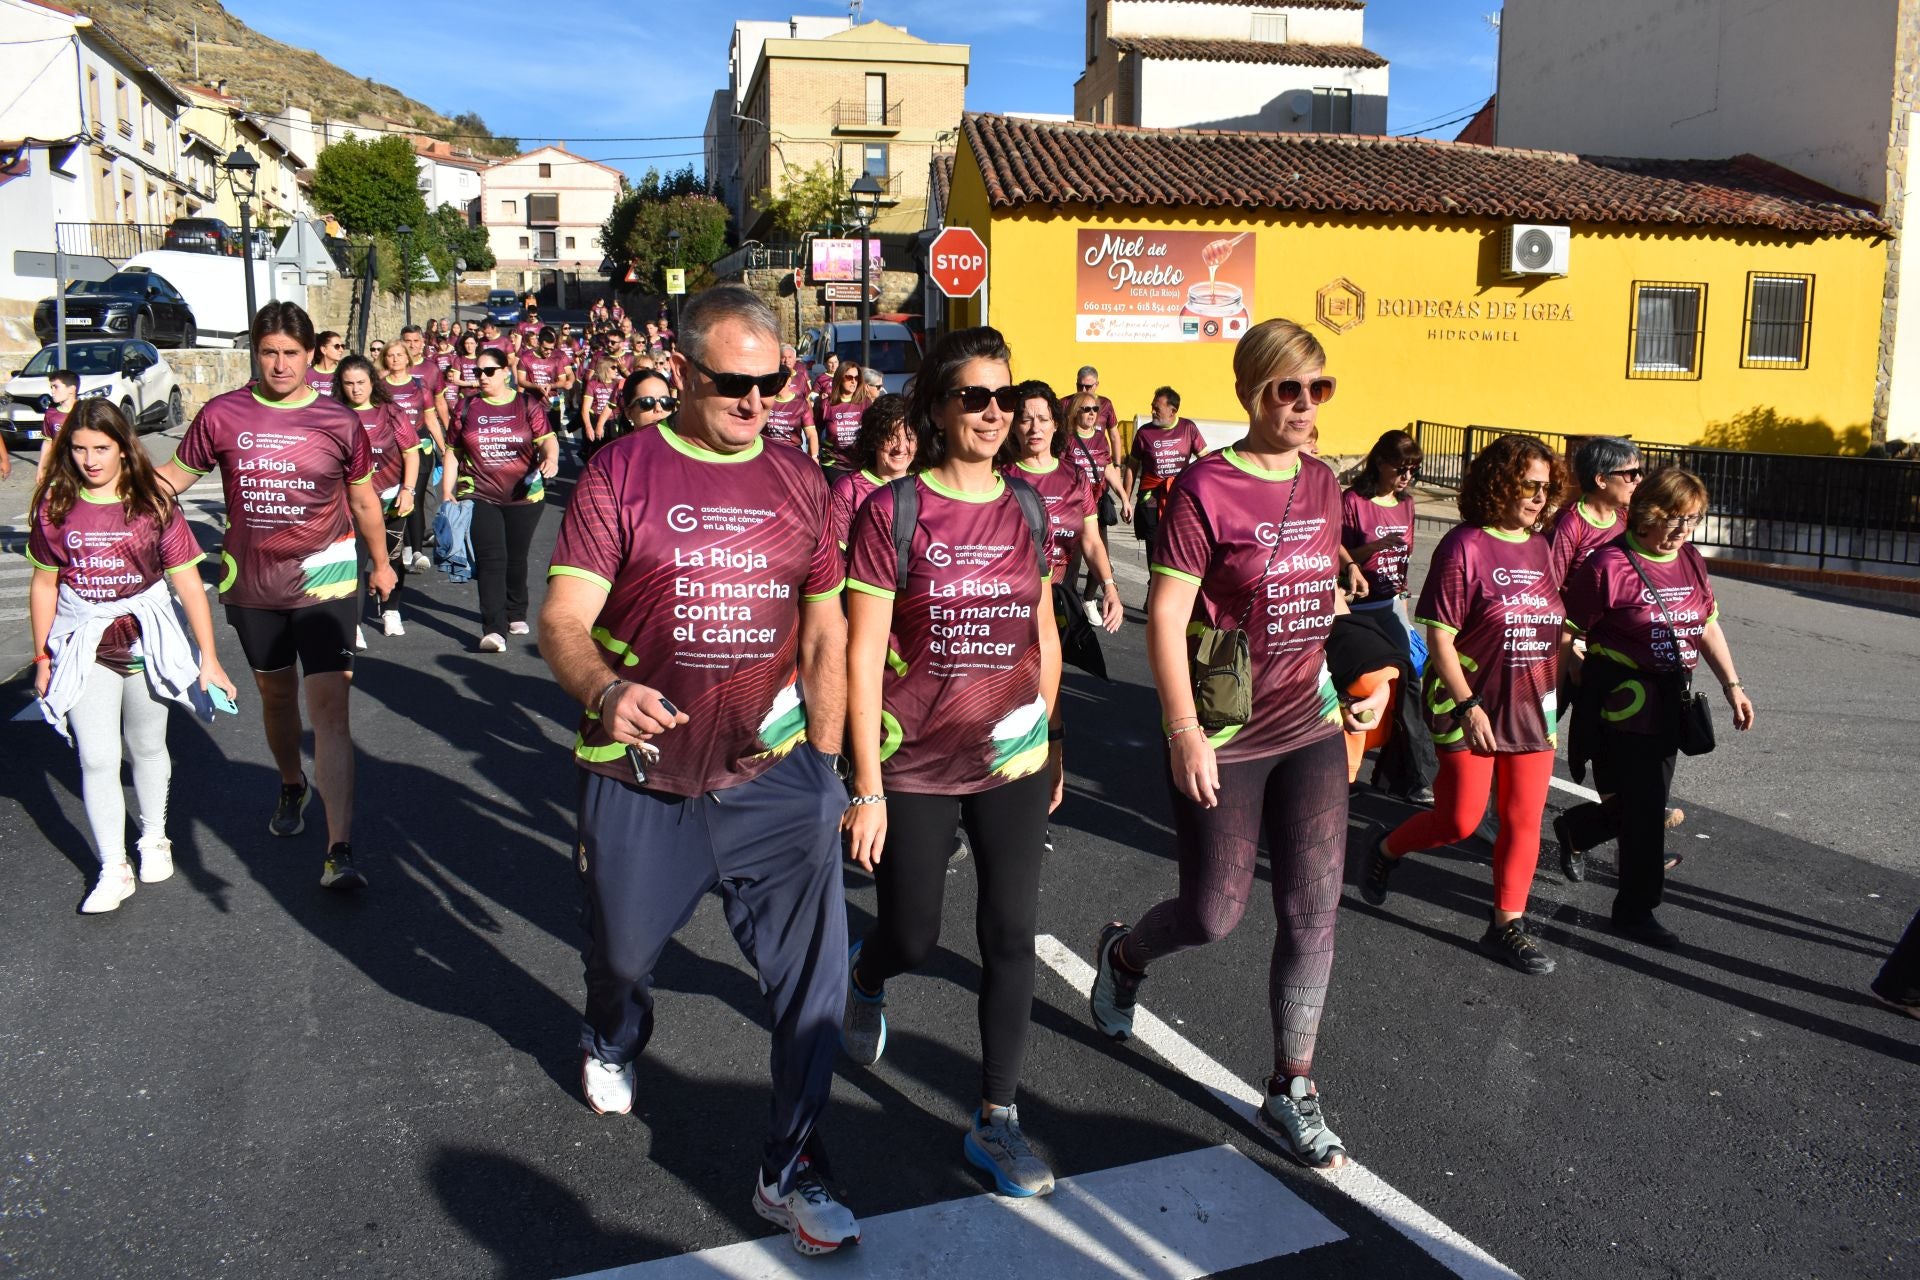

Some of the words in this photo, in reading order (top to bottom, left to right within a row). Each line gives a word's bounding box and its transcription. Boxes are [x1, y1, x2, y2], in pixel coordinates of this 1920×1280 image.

[1085, 233, 1144, 266] Miel
[1147, 243, 1167, 256] del
[936, 254, 983, 271] STOP
[1108, 258, 1185, 290] Pueblo
[1130, 288, 1148, 297] IGEA
[1150, 288, 1160, 298] (La
[1161, 288, 1180, 299] Rioja)
[1084, 302, 1100, 311] 660
[1101, 303, 1112, 312] 115
[1114, 303, 1126, 312] 417
[1137, 302, 1150, 311] 618
[1152, 303, 1165, 312] 854
[1167, 303, 1179, 312] 401
[1377, 298, 1480, 319] BODEGAS
[1487, 301, 1516, 320] DE
[1523, 302, 1575, 321] IGEA
[1427, 329, 1520, 342] HIDROMIEL
[479, 435, 490, 443] En
[492, 435, 524, 443] marcha
[481, 450, 490, 458] el
[238, 459, 255, 470] La
[258, 458, 296, 474] Rioja
[240, 476, 256, 487] En
[260, 478, 315, 490] marcha
[242, 490, 286, 502] contra
[243, 501, 254, 513] el
[256, 503, 306, 515] cáncer
[701, 506, 742, 514] asociación
[744, 508, 776, 517] española
[715, 523, 724, 531] La
[726, 524, 746, 533] Rioja
[738, 516, 763, 524] cáncer
[72, 557, 87, 568] La
[90, 556, 125, 570] Rioja
[674, 547, 704, 567] La
[711, 548, 768, 573] Rioja
[1265, 559, 1289, 575] La
[1292, 553, 1332, 571] Rioja
[76, 574, 88, 585] En
[91, 573, 143, 585] marcha
[675, 577, 705, 597] En
[711, 579, 790, 599] marcha
[929, 580, 956, 597] La
[962, 578, 1011, 599] Rioja
[1267, 583, 1289, 599] En
[1267, 597, 1320, 616] contra
[1502, 595, 1520, 606] La
[1521, 593, 1548, 609] Rioja
[674, 602, 752, 621] contra
[929, 605, 955, 620] En
[960, 602, 1031, 619] marcha
[1505, 612, 1521, 625] En
[1524, 612, 1563, 625] marcha
[1650, 611, 1666, 623] La
[930, 621, 990, 639] contra
[1267, 618, 1283, 634] el
[1288, 614, 1335, 632] cáncer
[673, 623, 696, 642] el
[702, 624, 777, 643] cáncer
[1651, 628, 1665, 639] En
[930, 640, 947, 656] el
[950, 638, 1015, 656] cáncer
[1503, 640, 1516, 652] el
